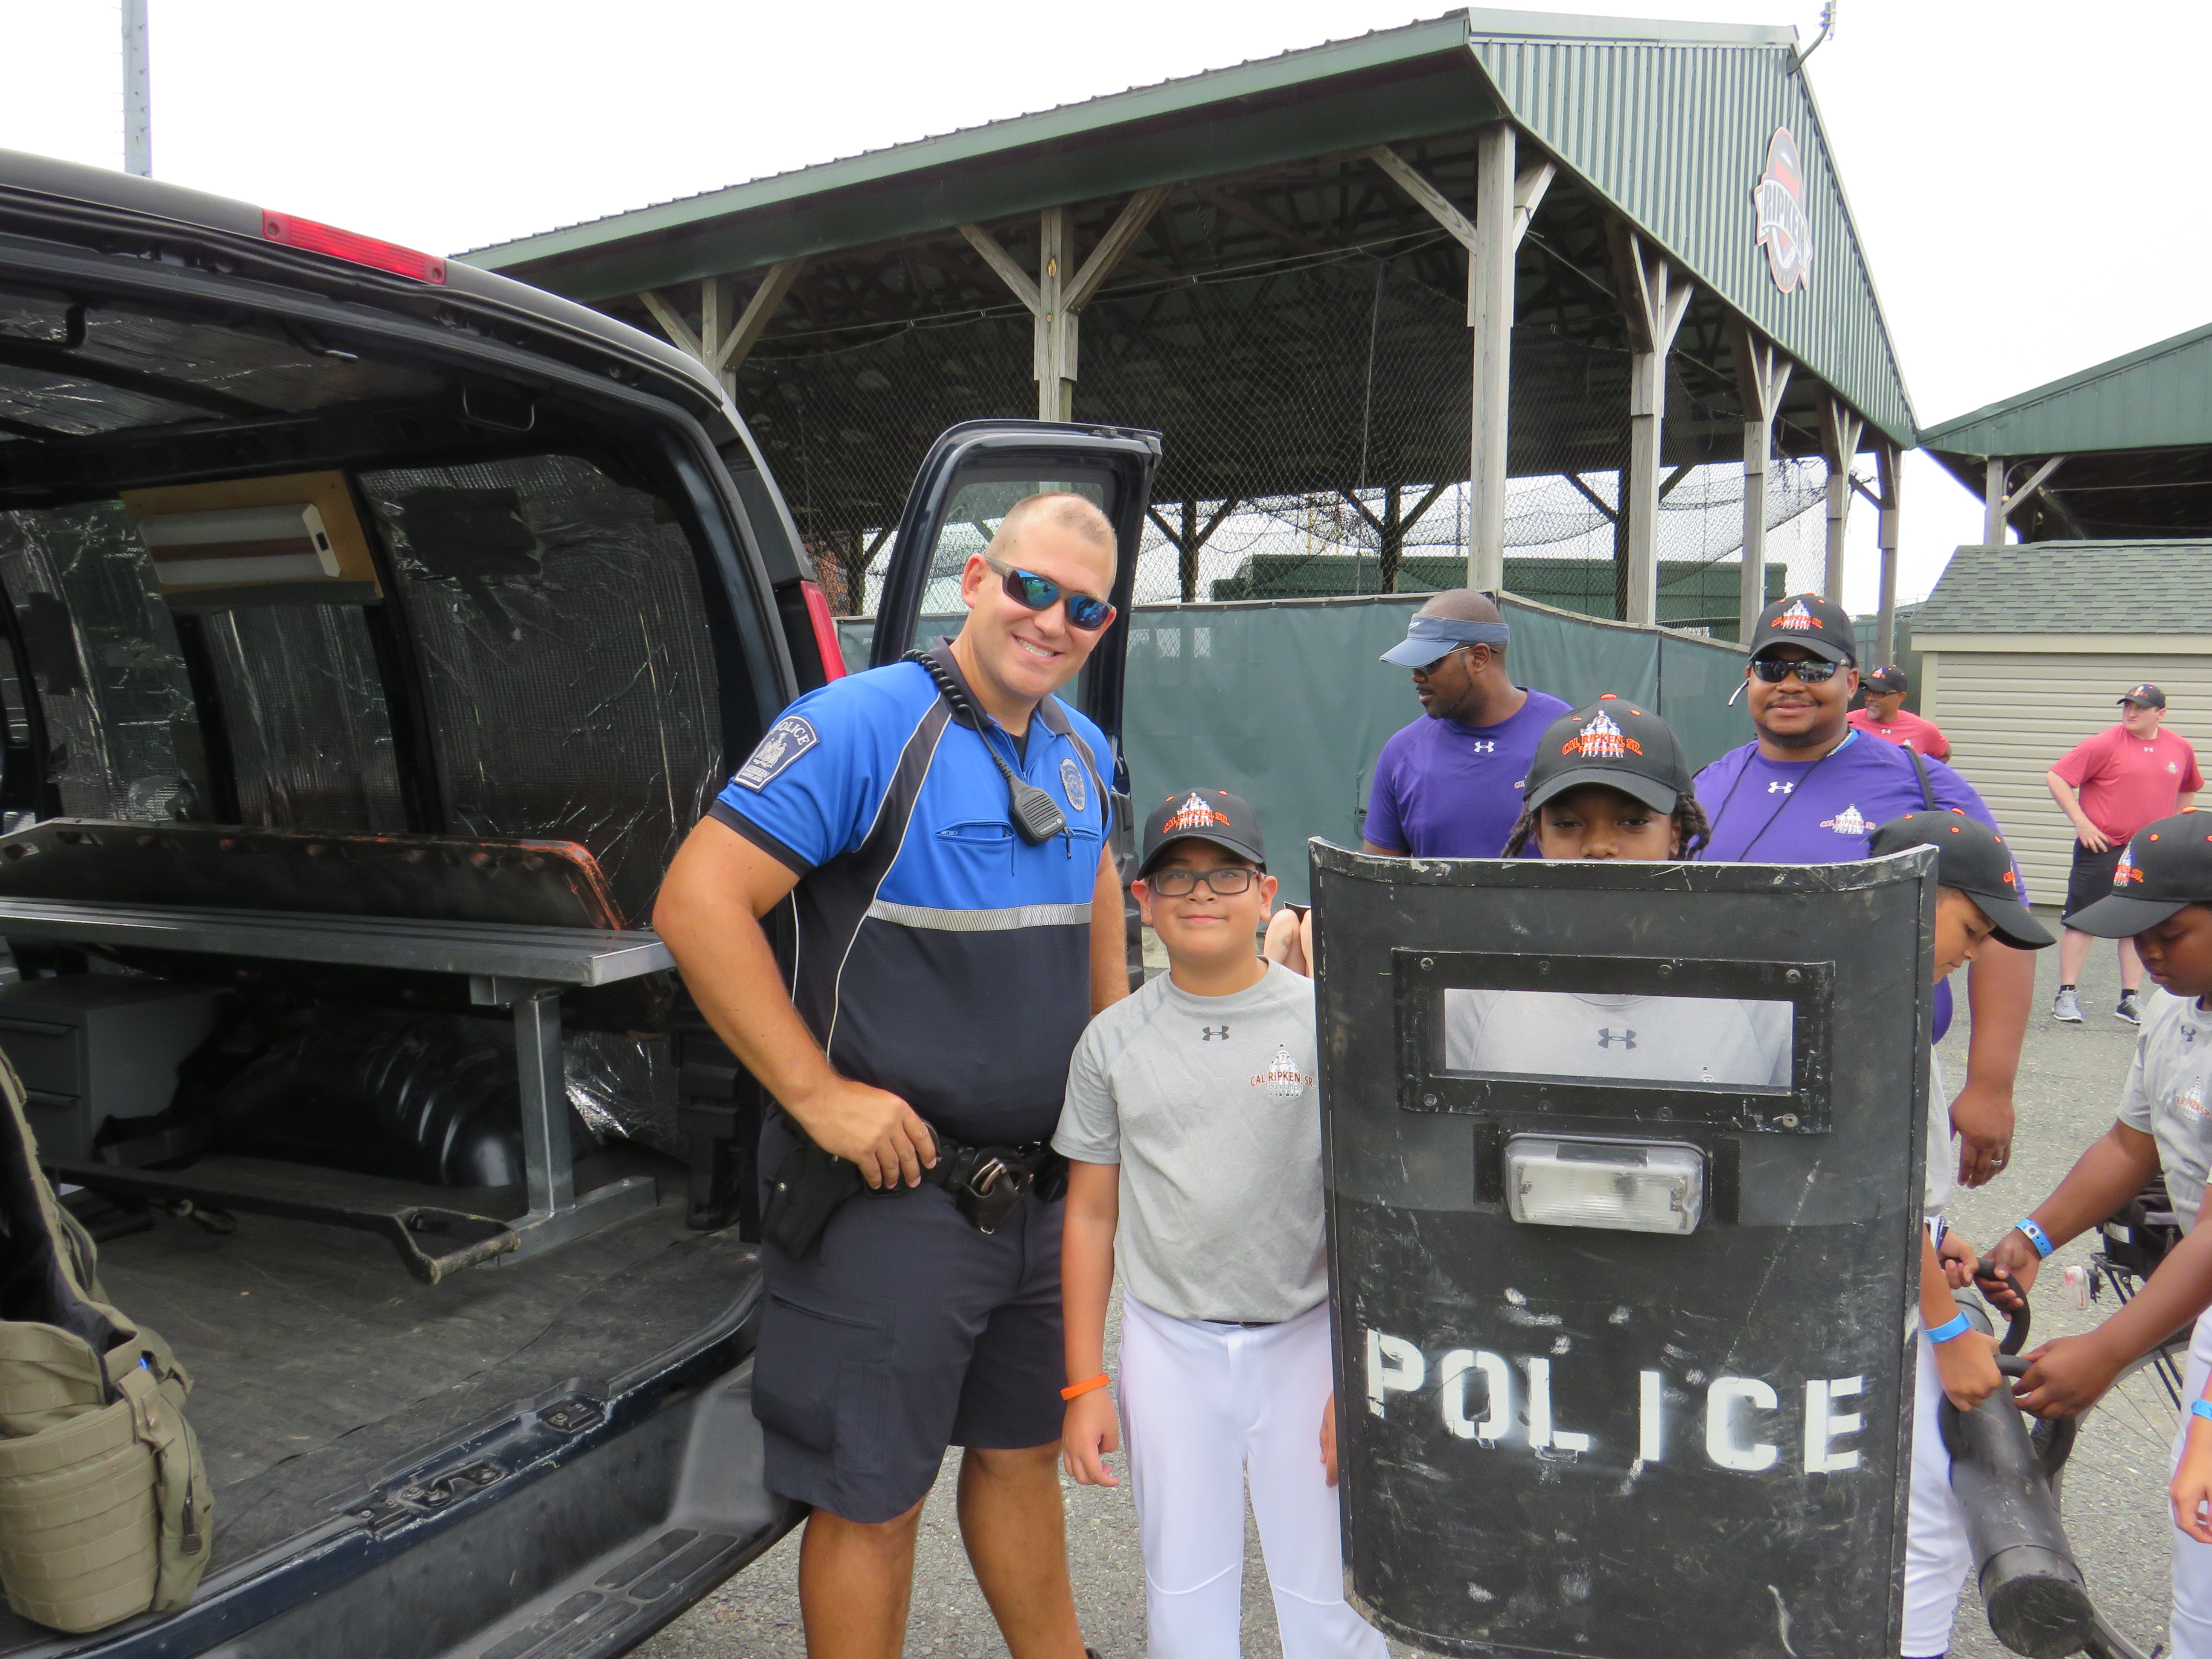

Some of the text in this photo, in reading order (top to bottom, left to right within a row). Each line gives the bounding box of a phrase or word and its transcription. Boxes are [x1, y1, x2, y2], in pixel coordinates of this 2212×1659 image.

[1763, 183, 1806, 264] RIPKEN
[770, 721, 810, 745] POLICE
[1562, 733, 1643, 755] CAL RIPKEN, SR.
[1163, 810, 1230, 833] CAL RIPKEN, SR.
[1819, 820, 1835, 828] CAL
[1250, 1071, 1316, 1089] CAL RIPKEN, SR.
[1266, 1083, 1303, 1091] Foundation
[1367, 1328, 1863, 1475] POLICE
